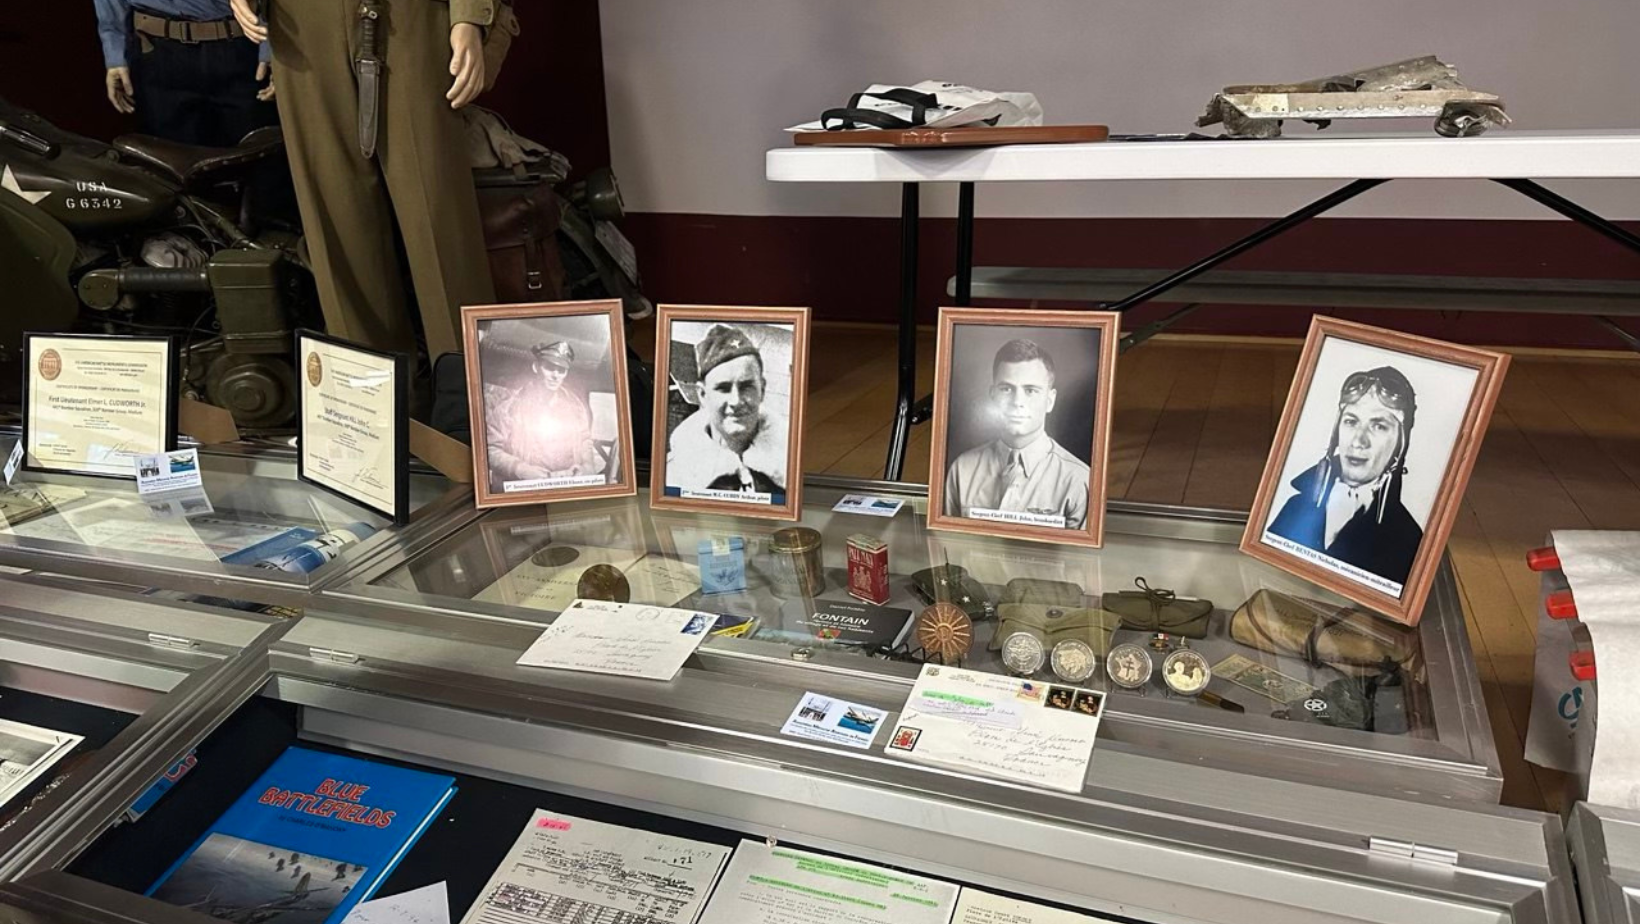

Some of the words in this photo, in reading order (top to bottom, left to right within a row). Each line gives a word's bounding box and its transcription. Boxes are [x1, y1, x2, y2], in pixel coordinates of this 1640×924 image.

[76, 181, 108, 193] USA
[811, 612, 870, 626] FONTAIN
[315, 778, 370, 802] BLUE
[258, 786, 397, 829] BATTLEFIELDS
